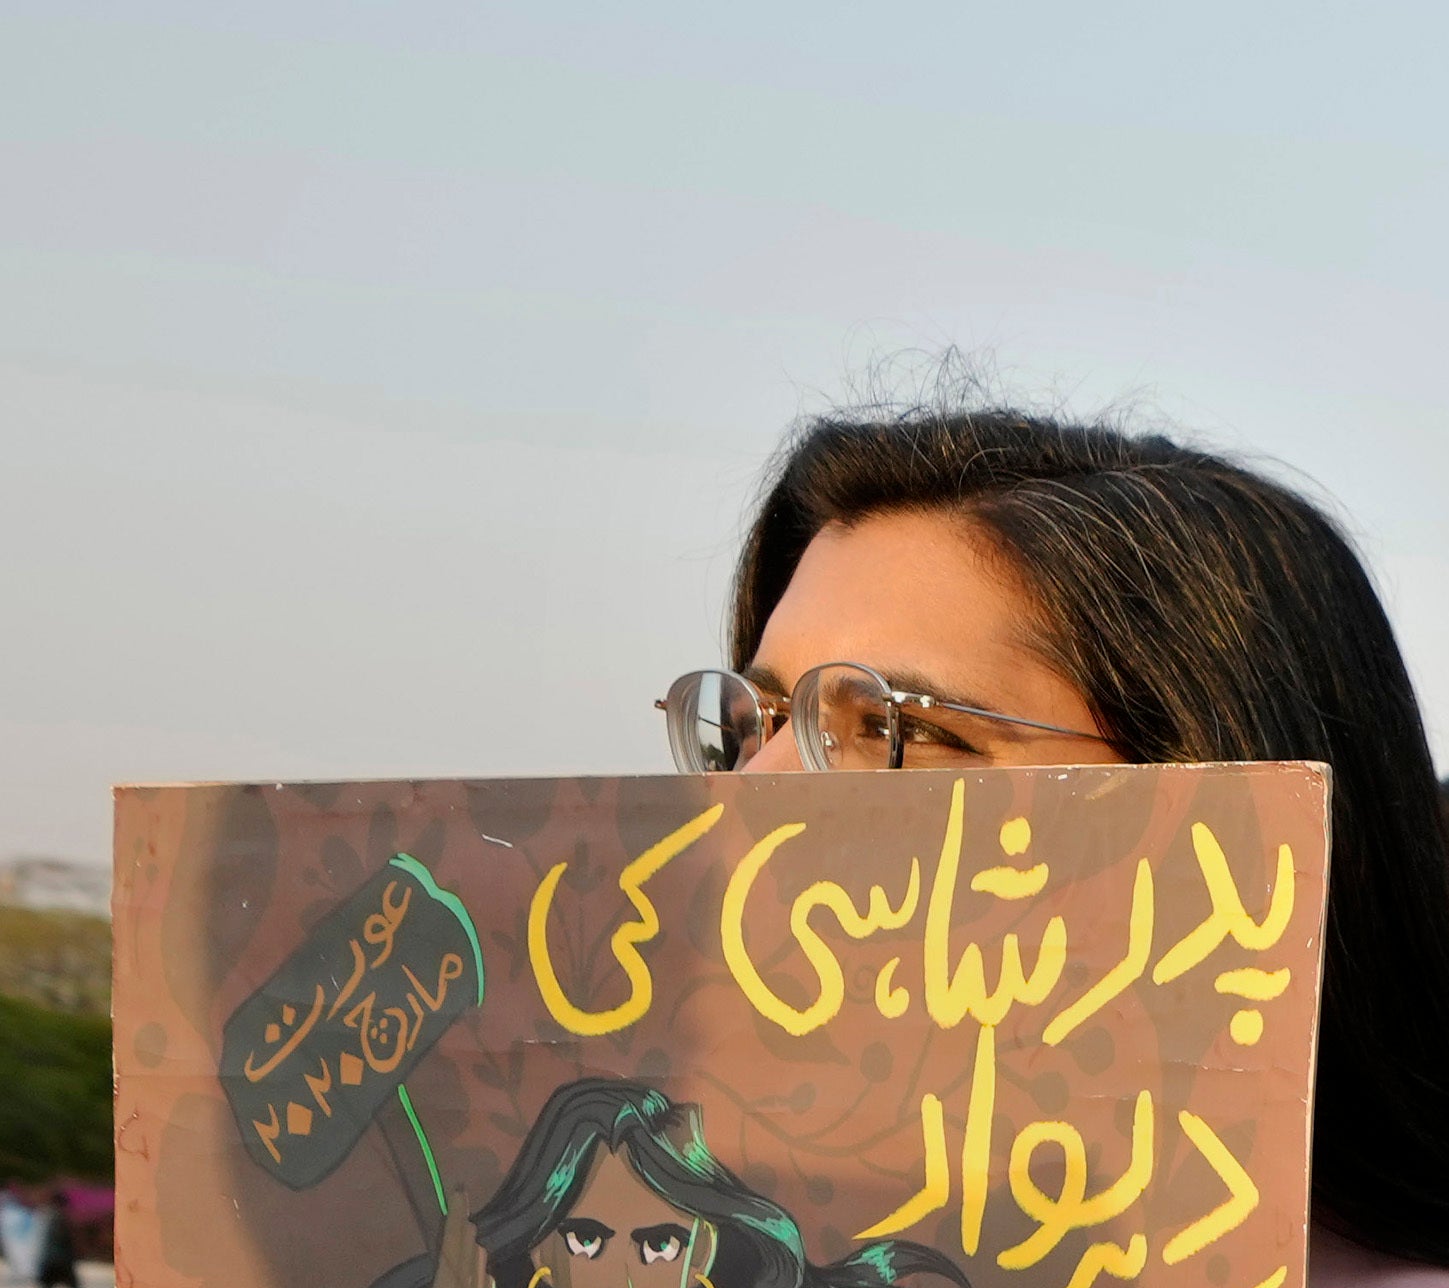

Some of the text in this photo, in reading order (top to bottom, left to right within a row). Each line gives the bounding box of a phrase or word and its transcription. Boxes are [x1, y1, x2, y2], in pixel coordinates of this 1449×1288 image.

[244, 880, 412, 1082] عورت
[343, 953, 463, 1074] مارچ
[527, 804, 724, 1036] کی
